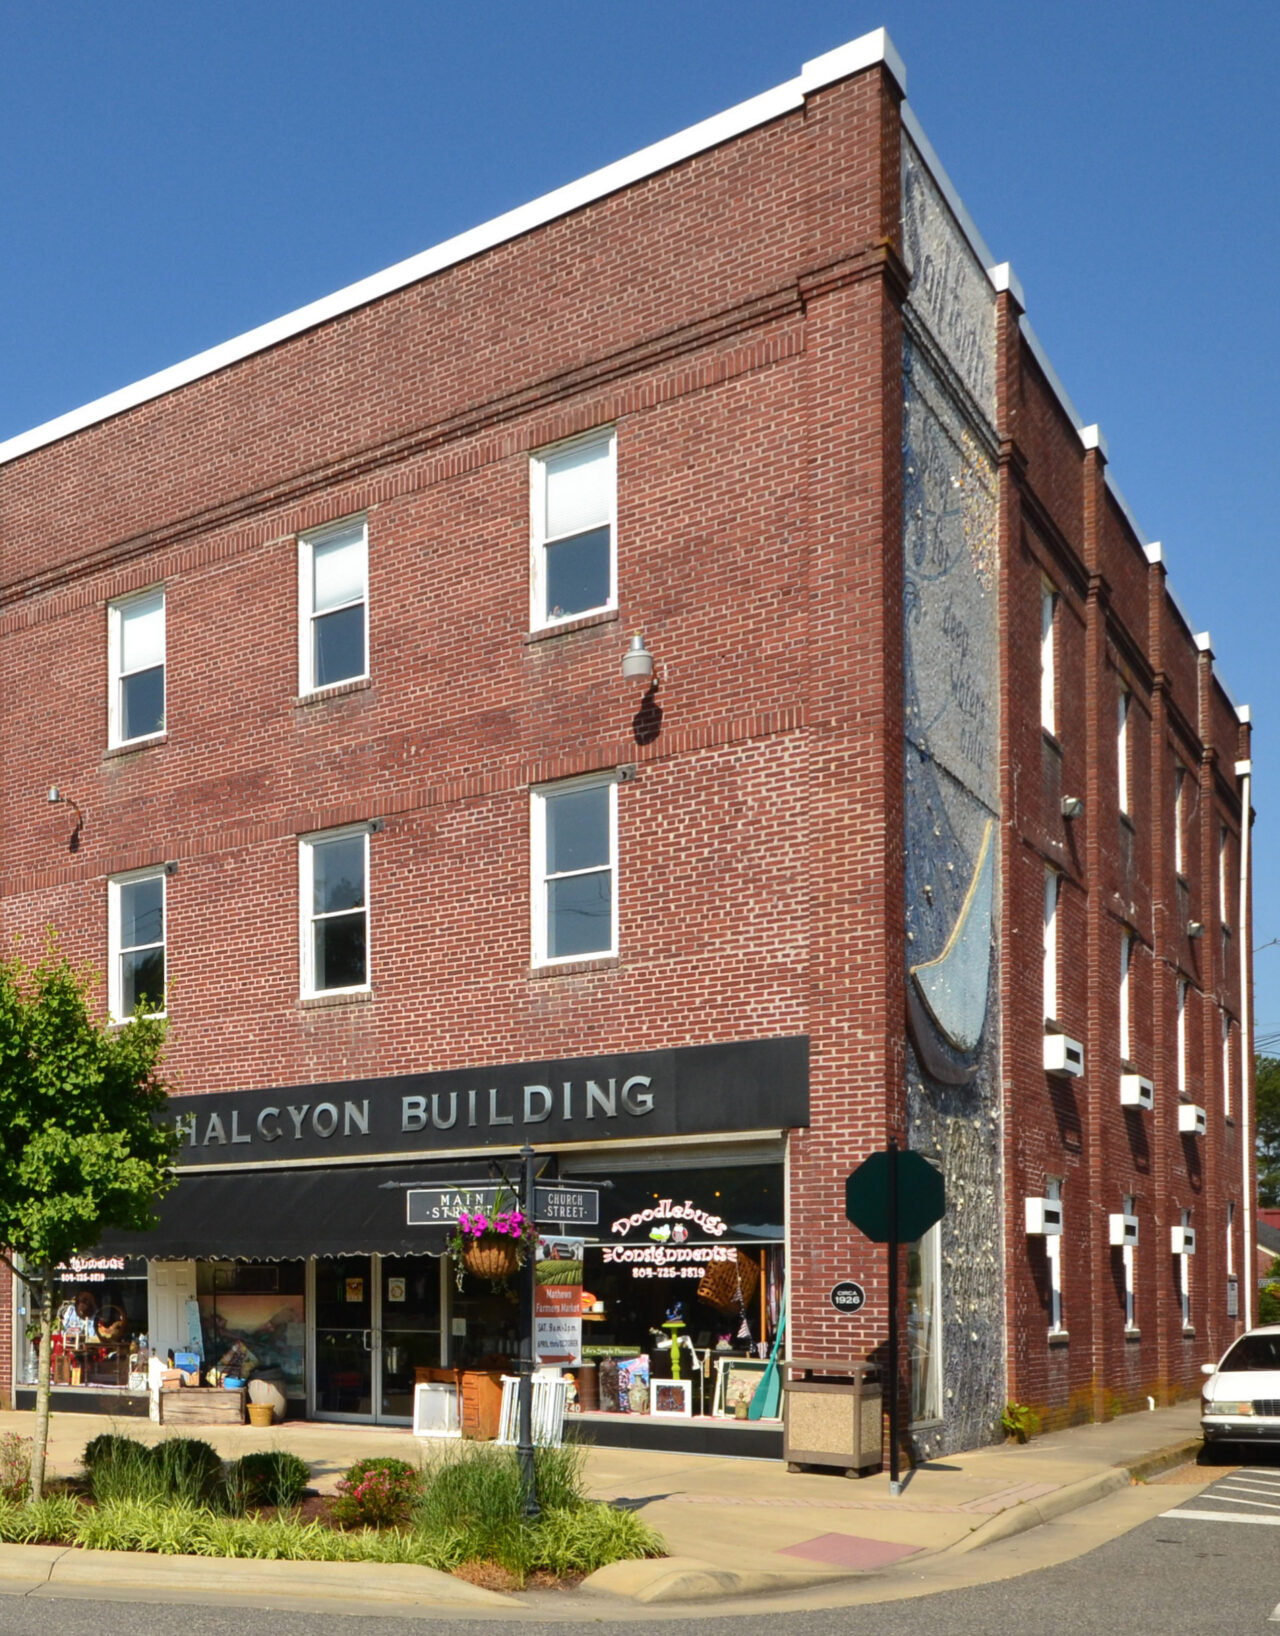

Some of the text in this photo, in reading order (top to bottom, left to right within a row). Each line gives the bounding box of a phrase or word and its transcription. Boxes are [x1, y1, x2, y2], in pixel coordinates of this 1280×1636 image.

[175, 1075, 655, 1147] HALCYON BUILDING
[440, 1193, 484, 1206] MAIN
[548, 1193, 583, 1205] CHURCH
[547, 1206, 585, 1218] STREET
[611, 1199, 728, 1236] Doodlebugs
[612, 1245, 727, 1265] Consignments
[546, 1288, 572, 1299] Mathews
[835, 1296, 860, 1304] 1926
[535, 1303, 580, 1313] Farmers Market
